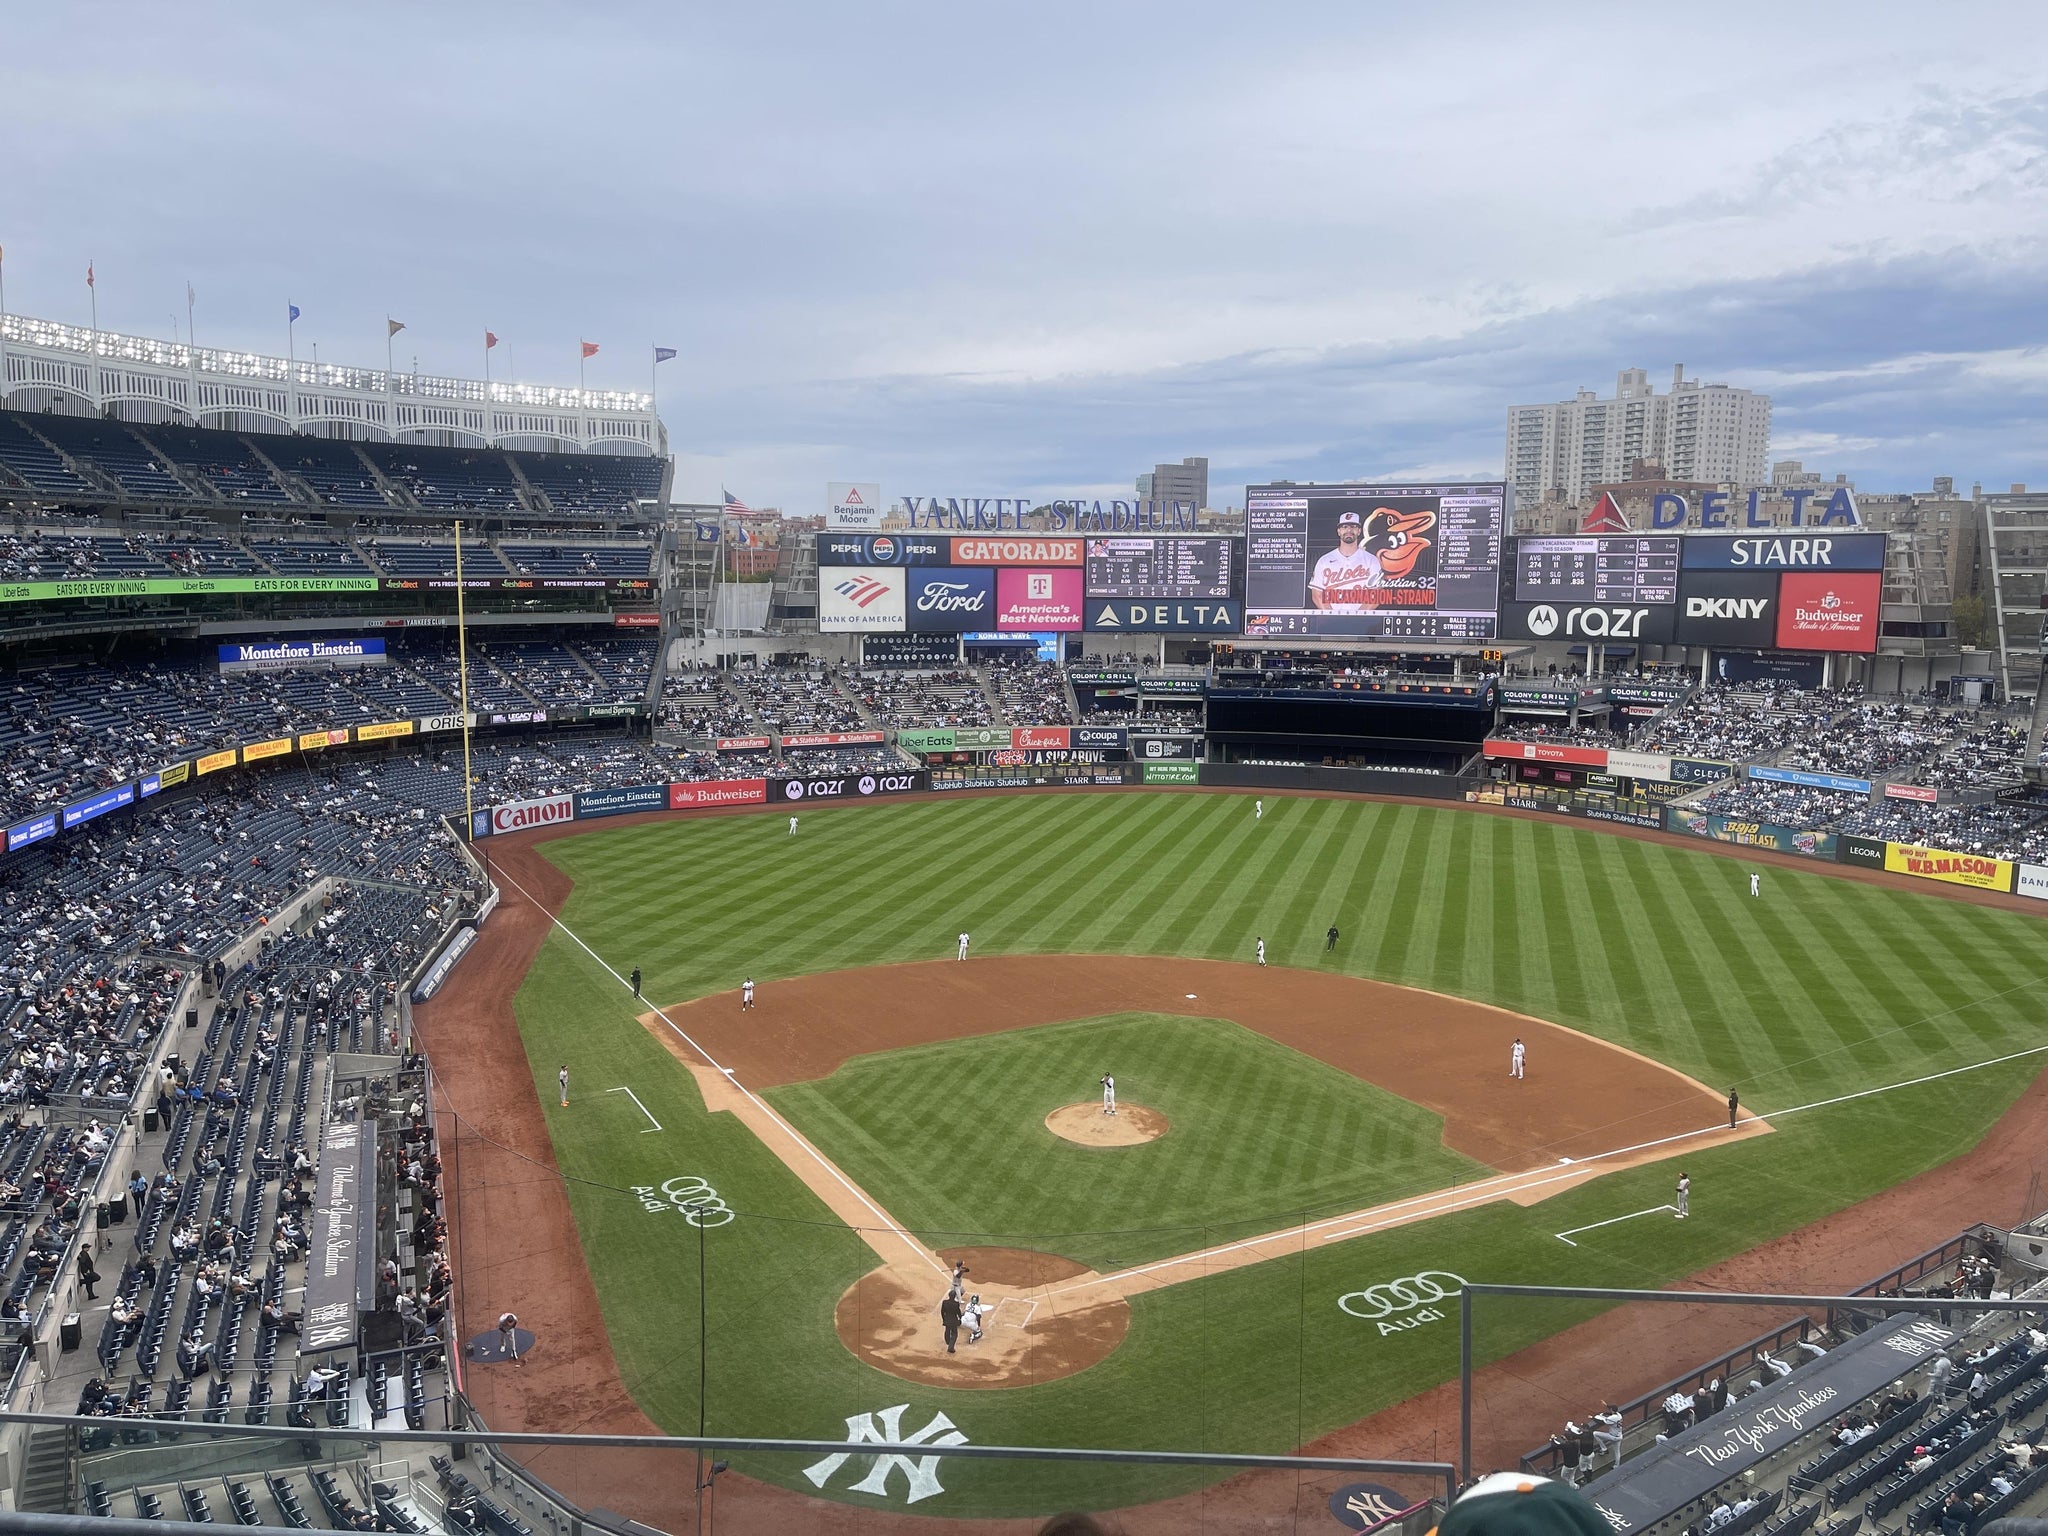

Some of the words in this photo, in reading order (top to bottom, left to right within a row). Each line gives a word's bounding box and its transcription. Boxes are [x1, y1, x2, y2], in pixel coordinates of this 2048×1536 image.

[834, 506, 875, 516] Benjamin
[901, 496, 1031, 531] YANKEE
[1051, 500, 1198, 532] STADIUM
[1653, 488, 1862, 529] DELTA
[839, 515, 868, 524] Moore
[831, 544, 862, 552] PEPSI
[906, 545, 936, 554] PEPSI
[959, 542, 1077, 561] GATORADE
[1730, 539, 1833, 565] STARR
[57, 584, 73, 596] EATS
[74, 584, 88, 595] FOR
[90, 583, 116, 594] EVERY
[118, 582, 146, 593] INNING
[182, 582, 199, 591] Uber
[199, 582, 215, 590] Eats
[255, 580, 278, 590] EATS
[280, 580, 299, 590] FOR
[303, 580, 334, 590] EVERY
[337, 580, 372, 589] INNING
[386, 579, 419, 589] freshdirect
[502, 579, 533, 588] freshdirect
[617, 579, 649, 588] freshdirect
[1418, 577, 1436, 589] 32
[3, 587, 17, 598] Uber
[17, 587, 30, 597] Eats
[917, 582, 986, 612] Ford
[1322, 589, 1435, 605] ENCARNACION-STRAND
[1009, 605, 1070, 614] America's
[1687, 597, 1768, 619] DKNY
[1000, 614, 1026, 623] Best
[1028, 614, 1080, 623] Network
[1130, 606, 1231, 625] DELTA
[1795, 609, 1863, 622] Budweiser
[1289, 621, 1295, 629] 2
[1566, 608, 1649, 637] razr
[1793, 622, 1818, 630] Made
[1826, 623, 1860, 631] America
[240, 644, 310, 661] Montefiore
[312, 641, 363, 657] Einstein
[508, 712, 532, 720] LEGACY
[589, 707, 613, 716] Poland
[613, 706, 636, 716] Spring
[430, 716, 465, 730] ORIS
[901, 736, 927, 747] Uber
[928, 737, 953, 746] Eats
[1091, 732, 1118, 742] coupa
[1149, 745, 1160, 753] GS
[1538, 749, 1564, 758] TOYOTA
[1036, 751, 1043, 764] A
[1694, 769, 1727, 780] CLEAR
[808, 780, 845, 796] razr
[879, 776, 915, 791] razr
[934, 782, 963, 791] StubHub
[965, 780, 995, 788] StubHub
[1649, 784, 1689, 796] NEREUS
[697, 789, 762, 802] Budweiser
[1887, 787, 1916, 797] Reebok
[1998, 787, 2025, 797] LEGORA
[581, 795, 625, 807] Montefiore
[627, 791, 661, 801] Einstein
[1510, 798, 1537, 809] STARR
[494, 801, 571, 830] Canon
[1587, 810, 1611, 819] StubHub
[1613, 814, 1635, 824] StubHub
[1637, 818, 1660, 828] StubHub
[1727, 822, 1760, 834] Baja
[1750, 834, 1775, 847] BLAST
[1850, 846, 1881, 859] LEGORA
[1898, 848, 1914, 857] WHO
[1915, 850, 1928, 858] BUT
[1907, 858, 1997, 877] W.B.MASON
[331, 1165, 354, 1198] Welcome
[331, 1197, 349, 1207] to
[630, 1187, 671, 1213] Audi
[318, 1204, 354, 1237] Yankee
[324, 1238, 351, 1277] Stadium
[1376, 1307, 1445, 1337] Audi
[1686, 1443, 1740, 1466] New
[1725, 1414, 1779, 1453] York
[1763, 1386, 1838, 1431] Yankees
